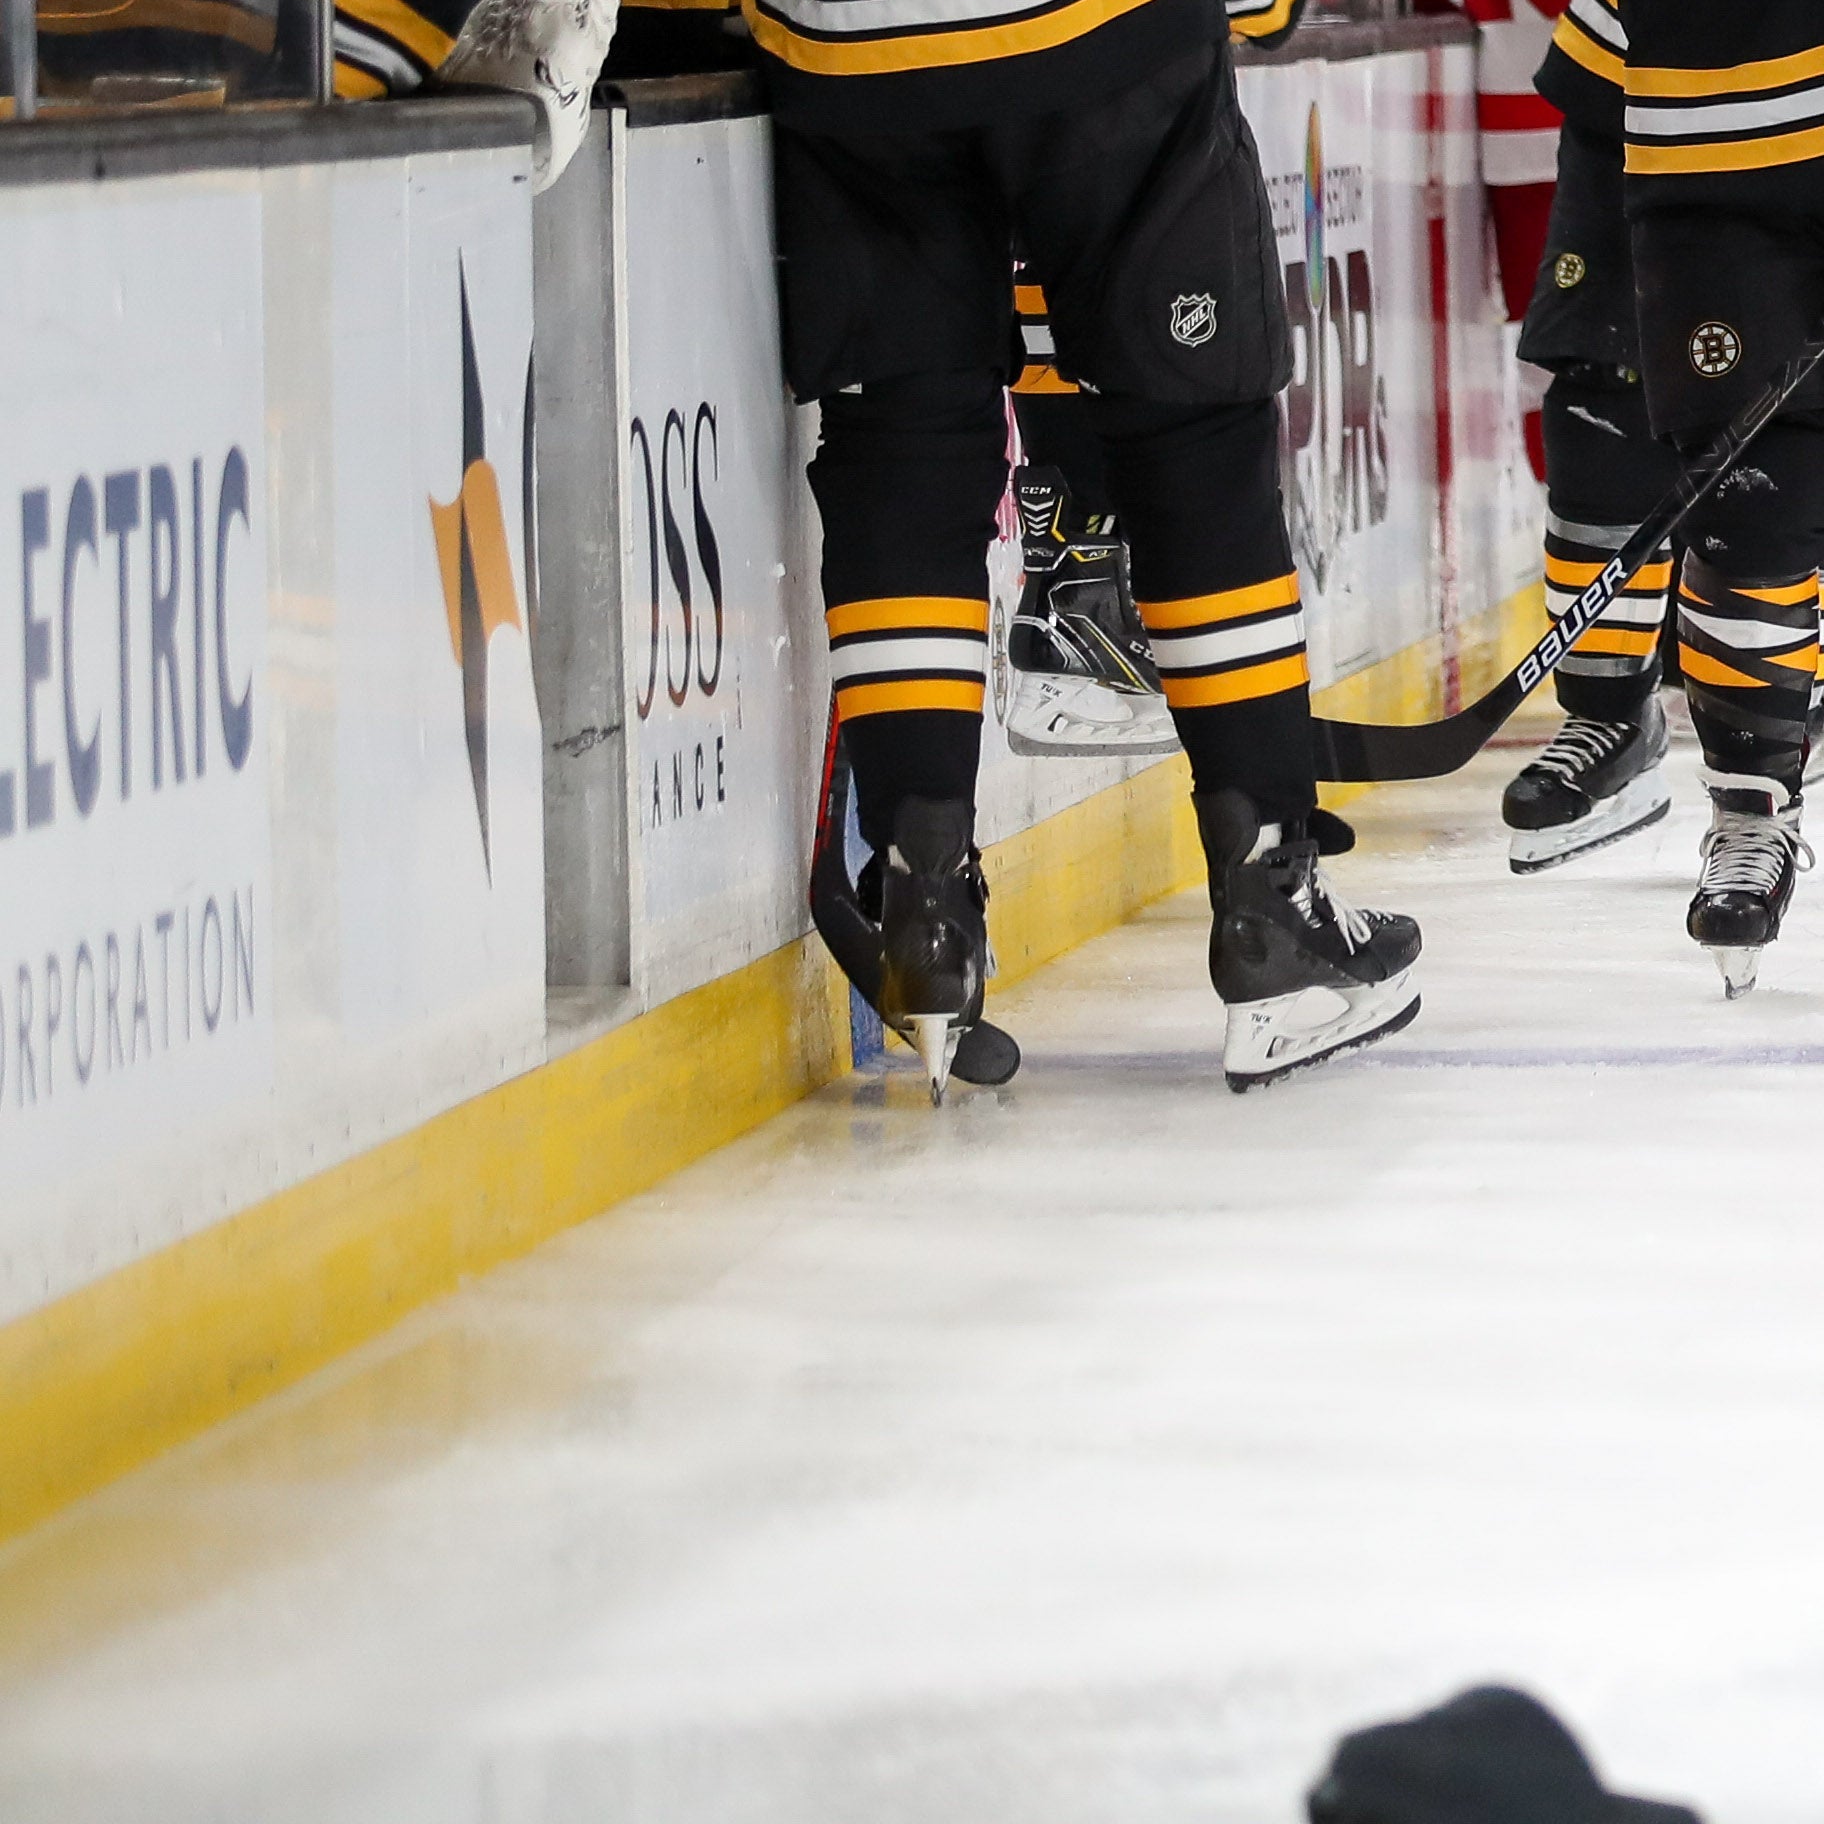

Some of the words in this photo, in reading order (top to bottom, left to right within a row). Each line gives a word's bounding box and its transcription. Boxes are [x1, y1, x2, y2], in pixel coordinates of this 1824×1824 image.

[1021, 486, 1052, 495] CCM
[0, 444, 254, 838] ECTRIC
[1516, 556, 1629, 694] BAUER
[652, 735, 725, 831] ANCE
